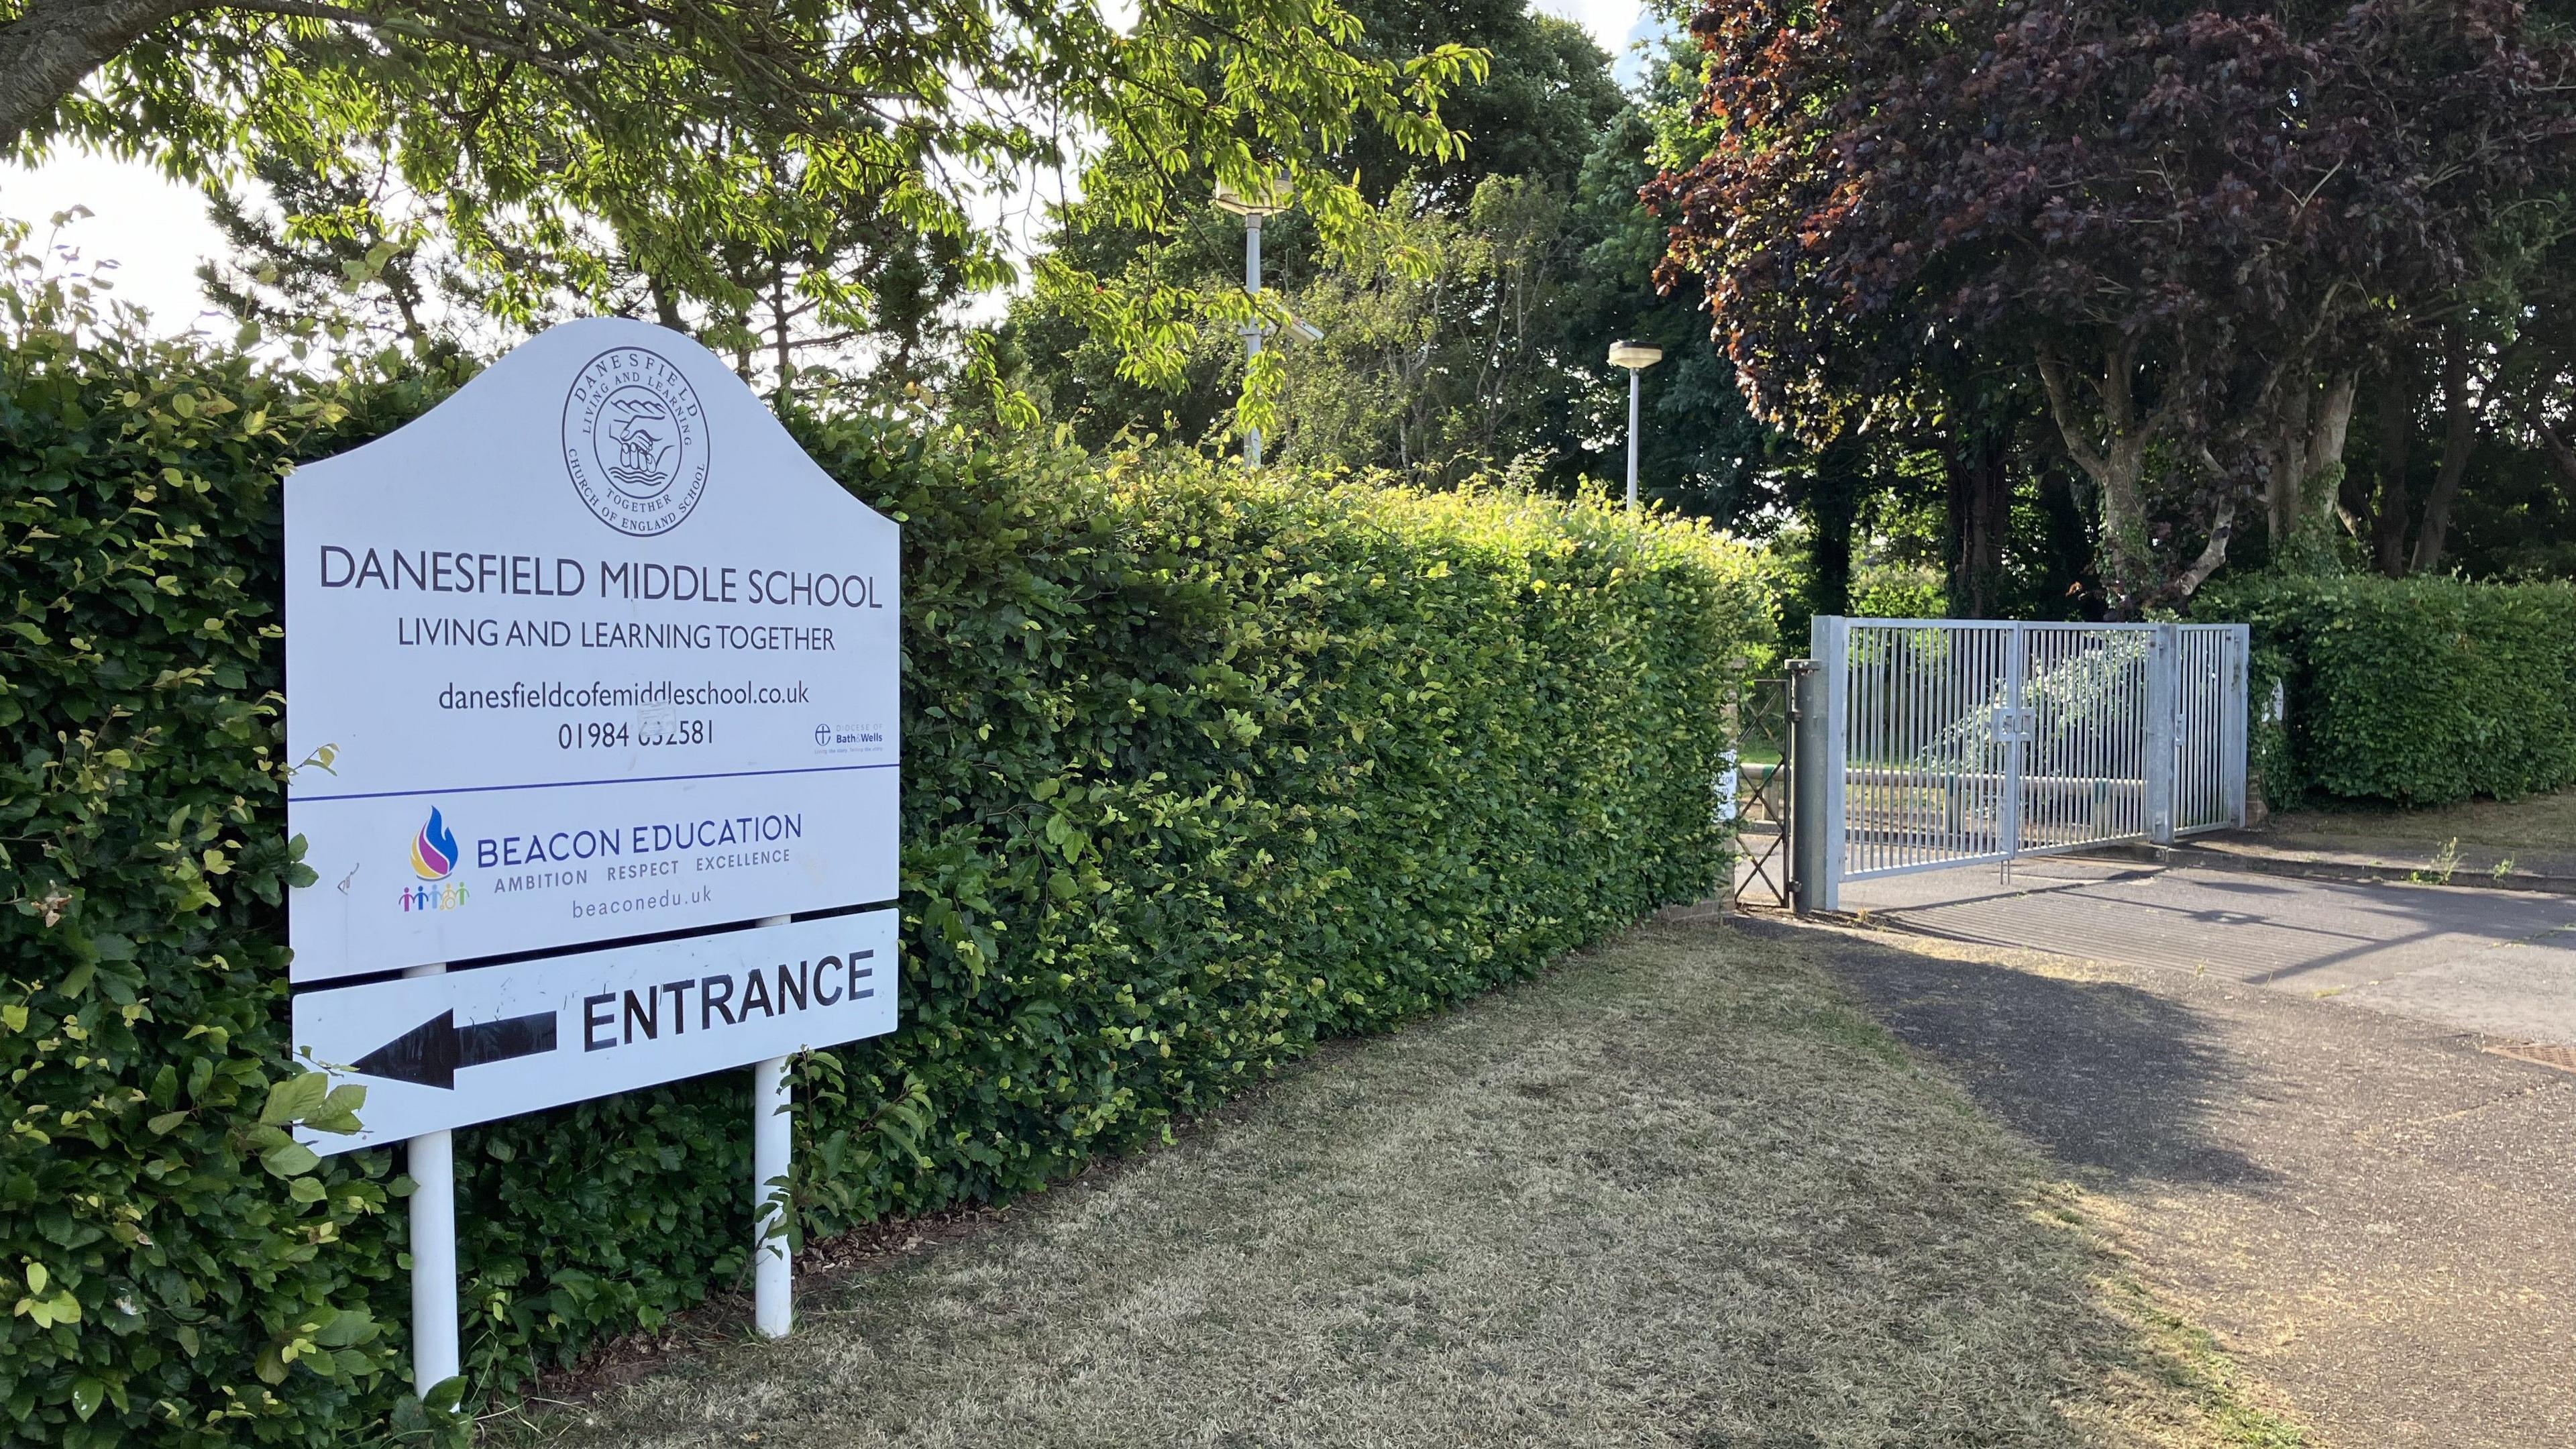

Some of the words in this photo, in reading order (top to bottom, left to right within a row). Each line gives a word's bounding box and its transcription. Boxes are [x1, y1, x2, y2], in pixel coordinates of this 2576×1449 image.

[574, 353, 698, 417] DANESFIELD
[583, 383, 609, 435] LIVING
[615, 372, 640, 385] AND
[648, 376, 692, 446] LEARNING
[568, 448, 599, 508] CHURCH
[602, 506, 617, 522] OF
[622, 512, 676, 531] ENGLAND
[678, 464, 705, 514] SCHOOL
[607, 488, 672, 513] TOGETHER
[321, 545, 585, 596] DANESFIELD
[601, 561, 737, 602] MIDDLE
[749, 570, 883, 608] SCHOOL
[398, 617, 498, 646] LIVING
[505, 620, 572, 647] AND
[581, 621, 710, 649] LEARNING
[716, 625, 836, 651] TOGETHER
[439, 681, 810, 708] danesfieldcofemiddleschool.co.uk
[558, 722, 629, 749] 01984
[836, 724, 869, 732] DIOCESE
[478, 828, 621, 868] BEACON
[633, 813, 802, 853] EDUCATION
[494, 869, 588, 893] AMBITION
[607, 860, 679, 881] RESPECT
[696, 849, 790, 871] EXCELLENCE
[572, 885, 712, 918] beaconedu.uk
[584, 949, 874, 1053] ENTRANCE
